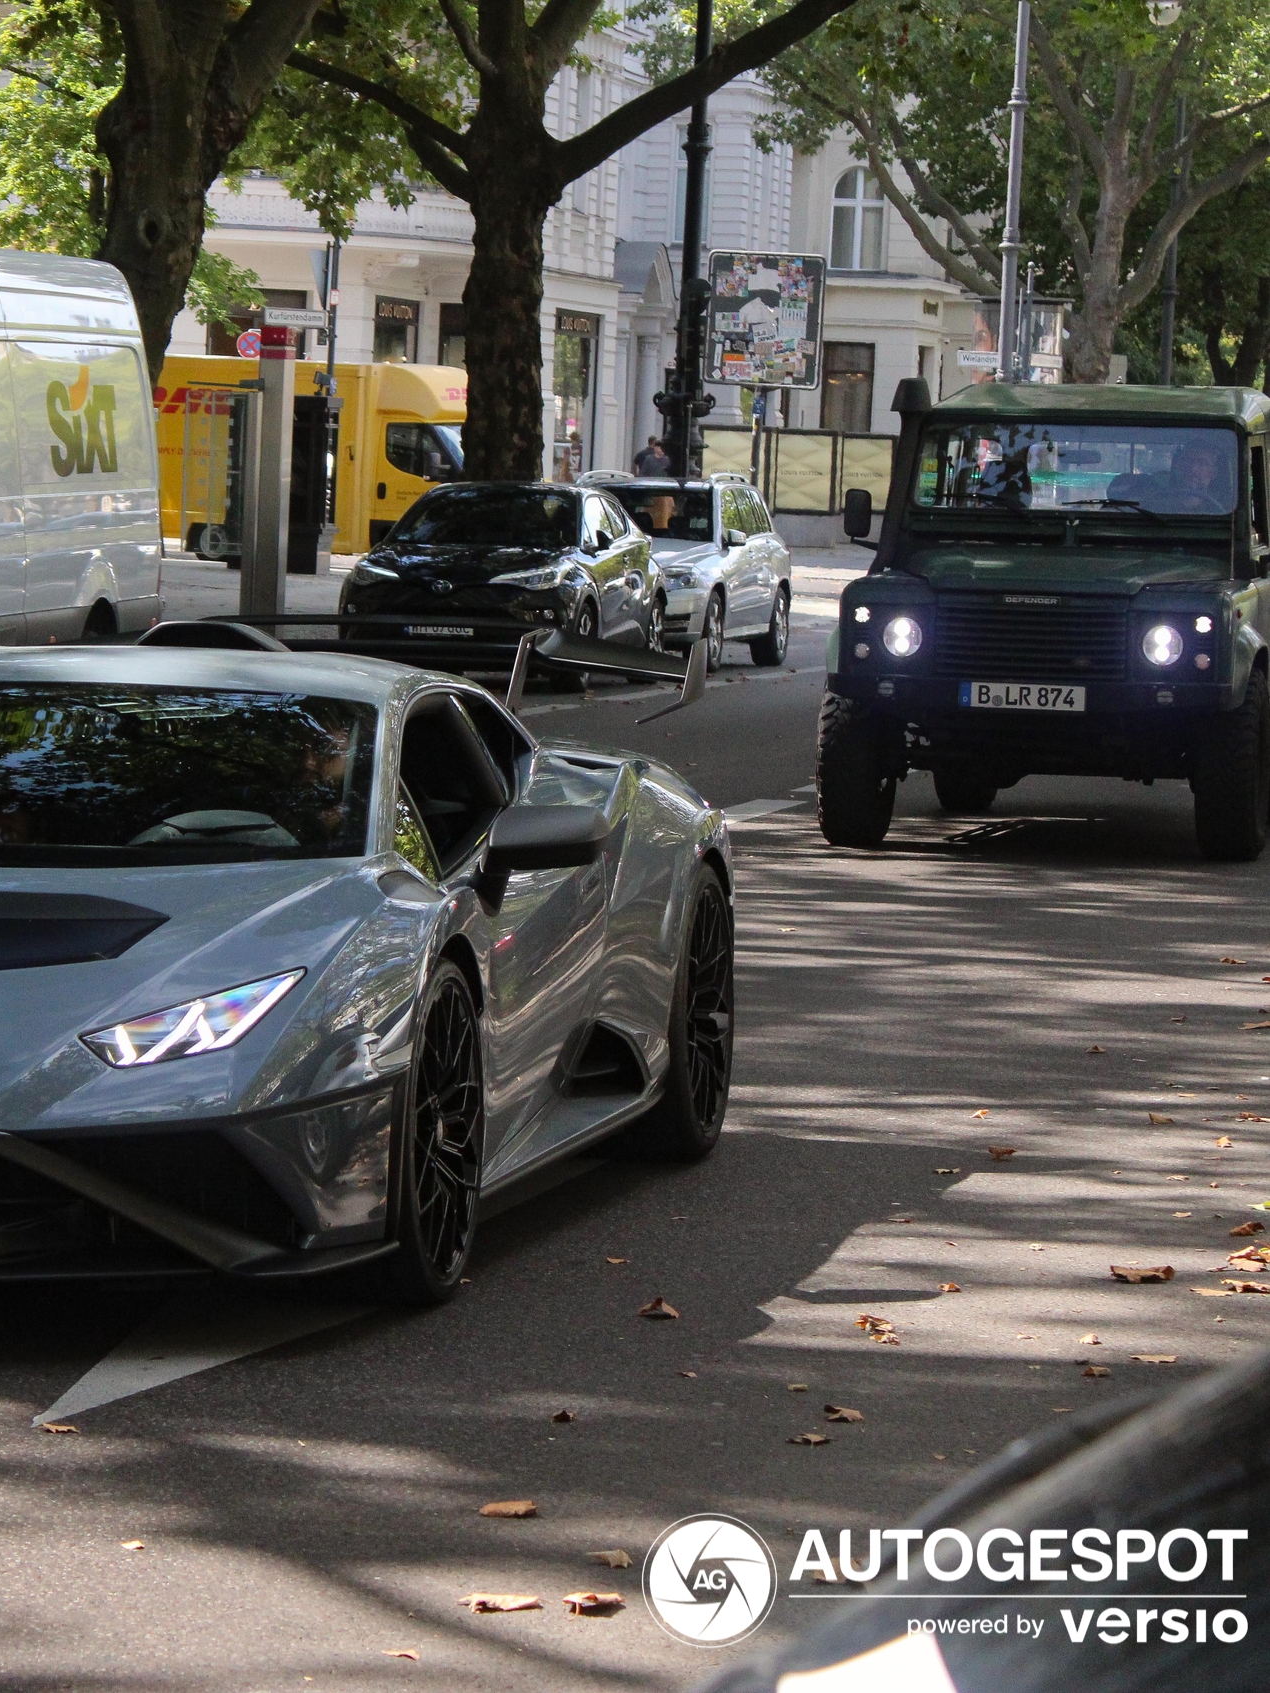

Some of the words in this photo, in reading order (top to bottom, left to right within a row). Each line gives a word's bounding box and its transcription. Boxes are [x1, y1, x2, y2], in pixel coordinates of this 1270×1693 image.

[269, 311, 323, 322] Kurfürstendamm
[1005, 596, 1058, 605] DEFENDER
[978, 685, 991, 705] B
[1037, 687, 1075, 708] 874
